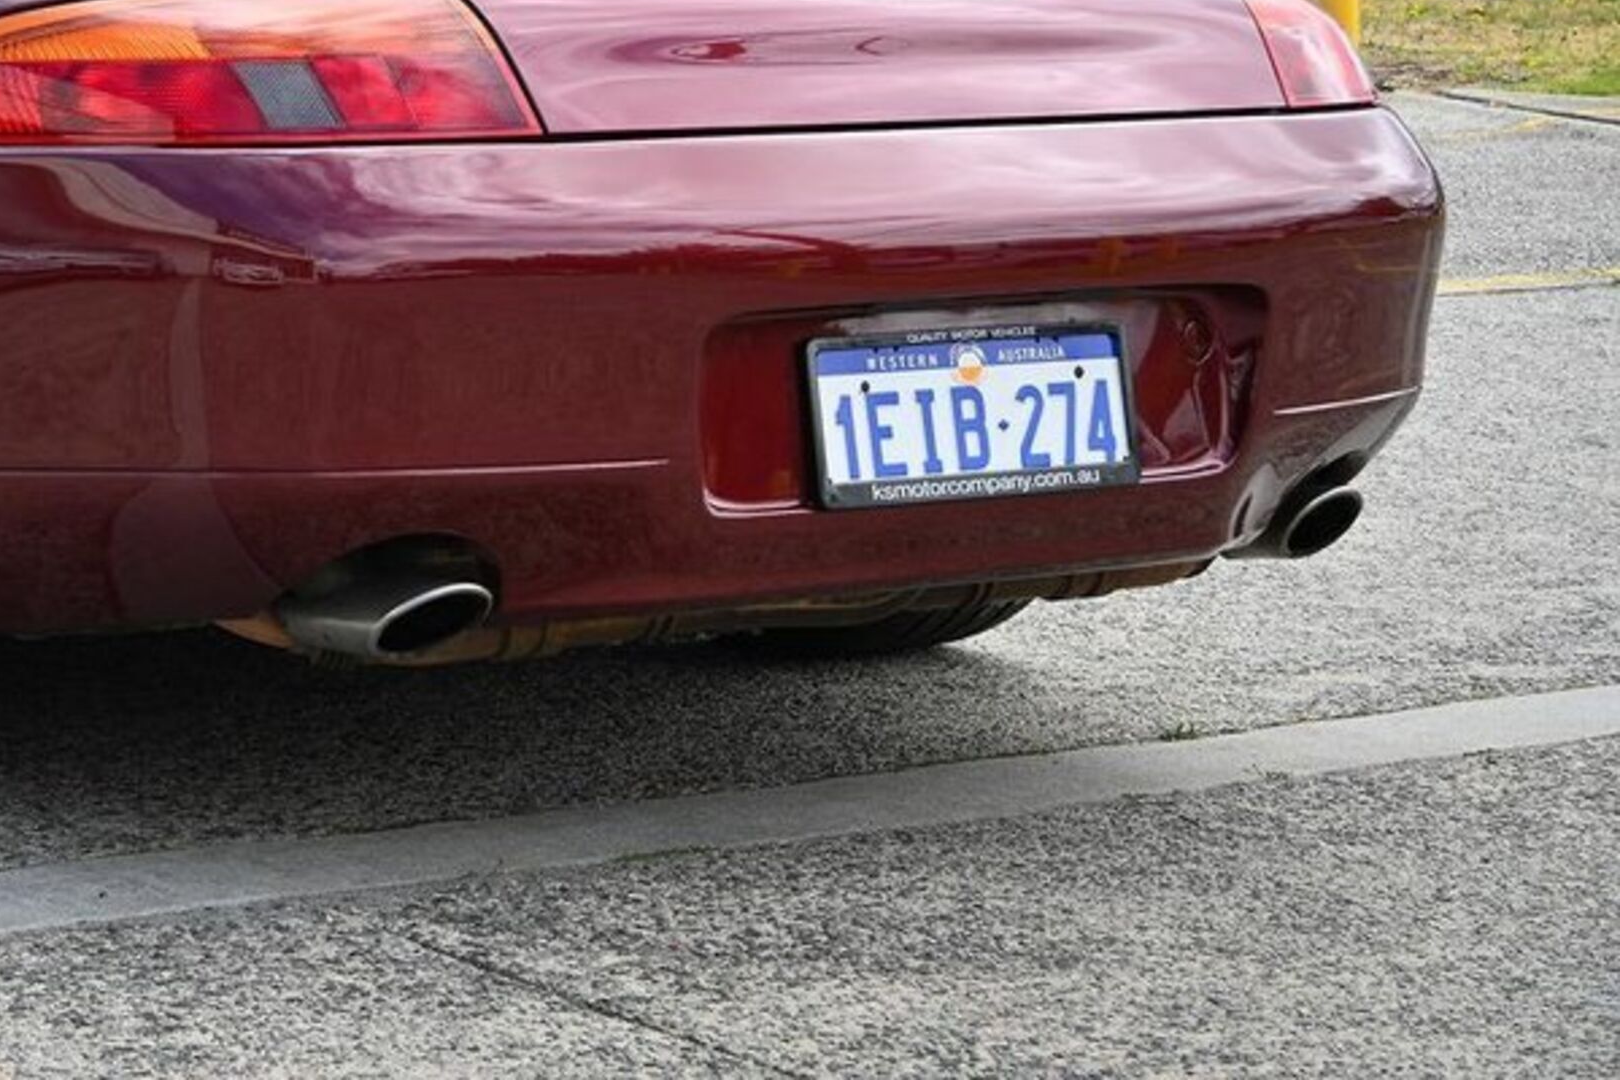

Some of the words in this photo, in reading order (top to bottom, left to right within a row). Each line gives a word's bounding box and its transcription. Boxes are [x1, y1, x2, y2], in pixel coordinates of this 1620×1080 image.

[906, 331, 948, 344] QUALITY
[950, 329, 988, 341] MOTOR
[990, 325, 1037, 338] VEHICLES
[866, 354, 938, 371] WESTERN
[996, 345, 1066, 362] AUSTRALIA
[871, 468, 1101, 502] ksmotorcompany.com.au
